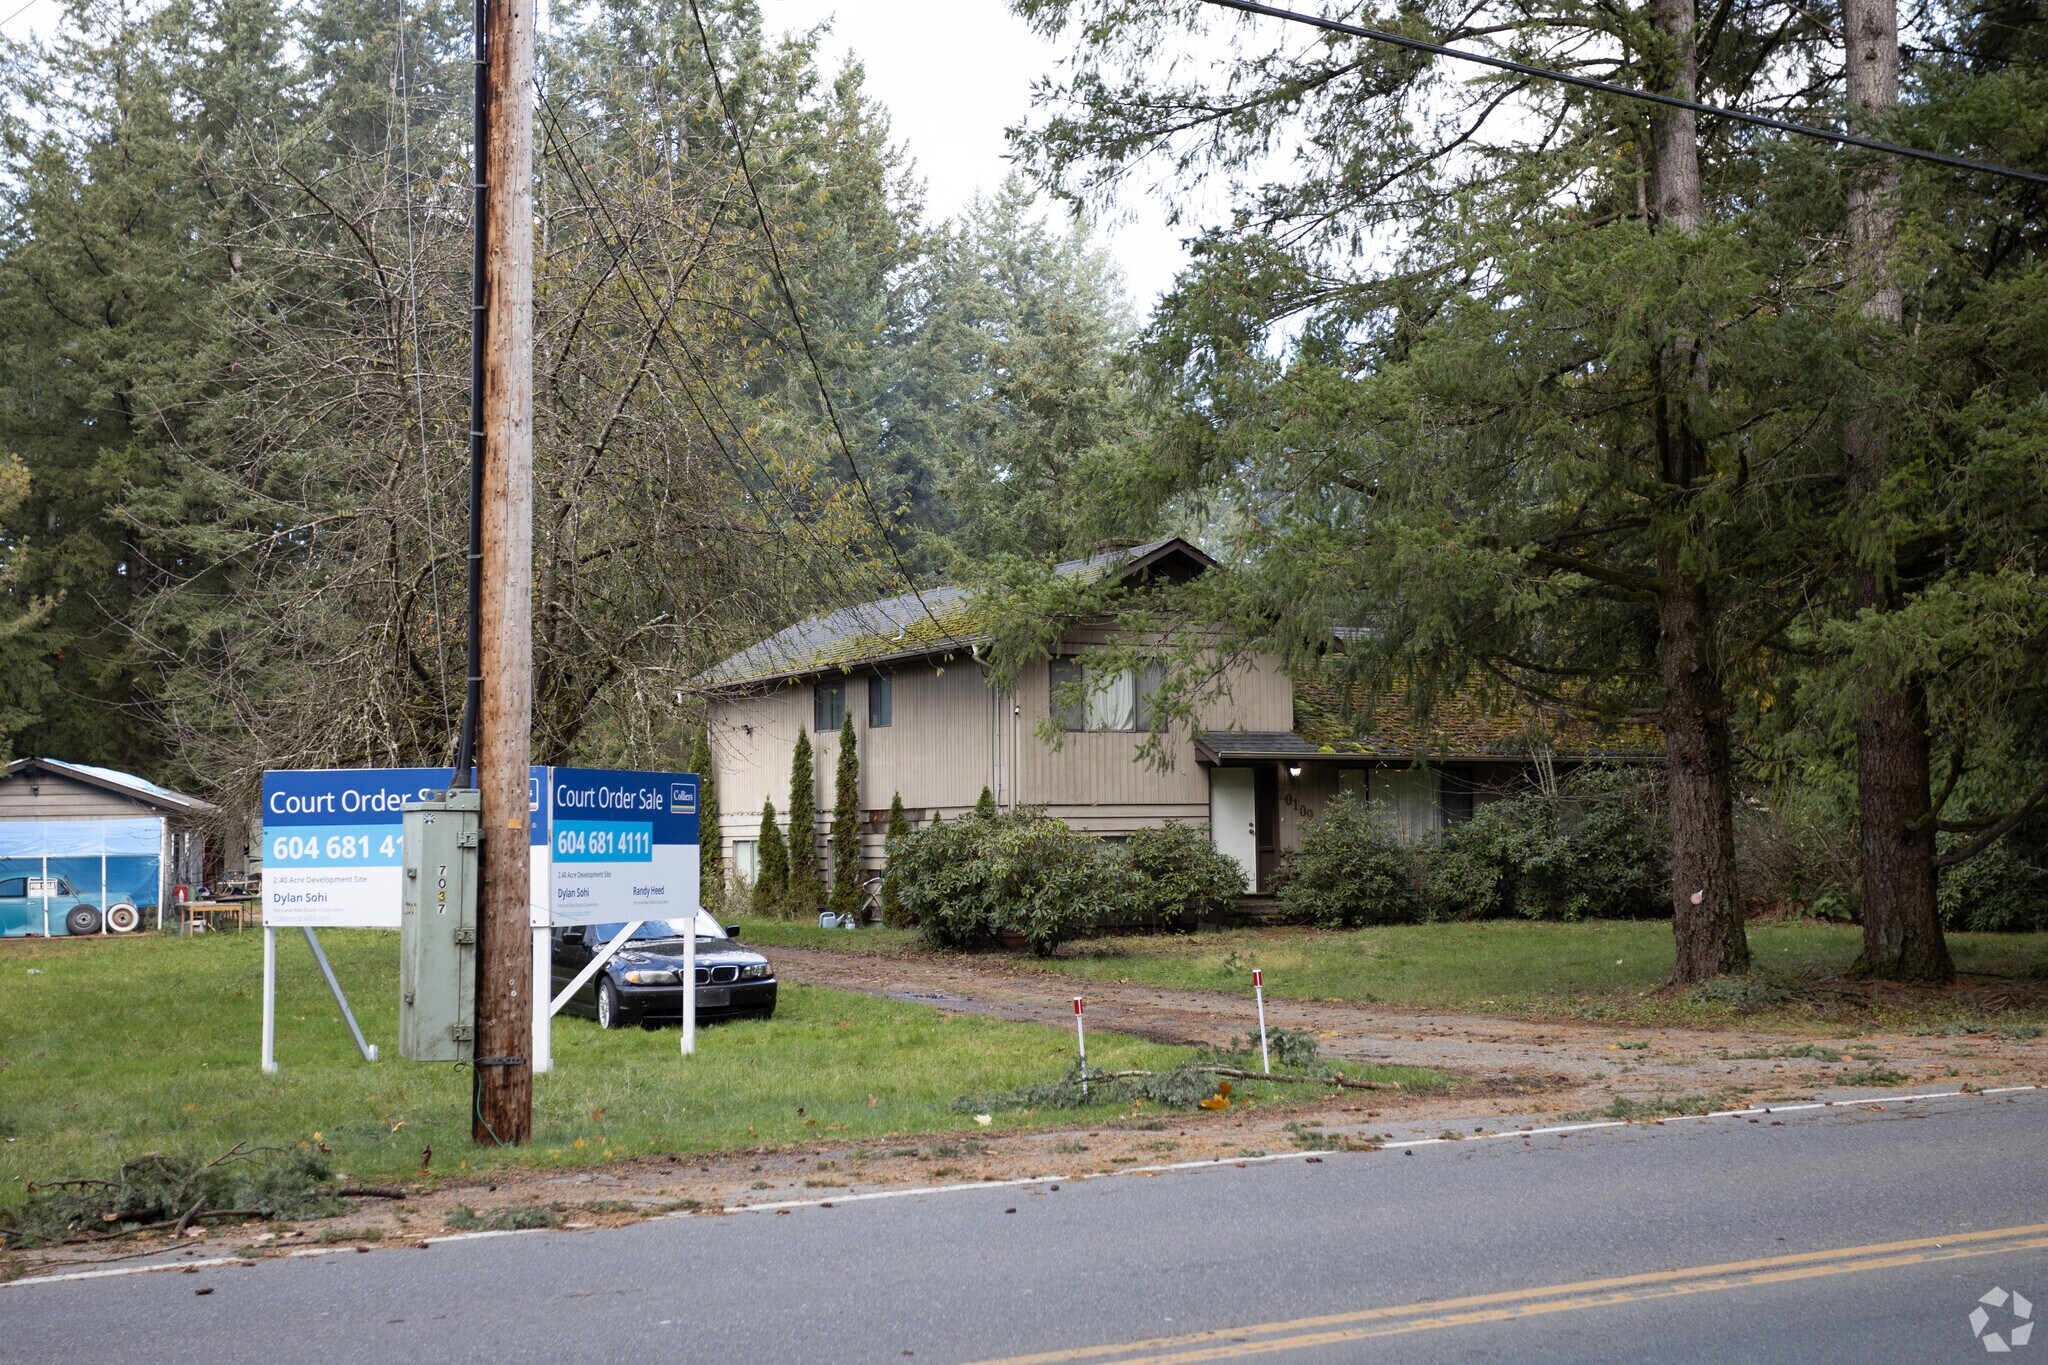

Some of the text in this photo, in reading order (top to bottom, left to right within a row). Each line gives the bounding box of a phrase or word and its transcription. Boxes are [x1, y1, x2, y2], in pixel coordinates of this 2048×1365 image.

[270, 791, 335, 814] Court
[341, 788, 411, 813] Order
[557, 784, 663, 810] Court Order Sale
[673, 789, 693, 801] Colliers
[273, 835, 320, 860] 604
[326, 835, 369, 859] 681
[558, 830, 649, 854] 604 681 4111
[273, 875, 367, 885] 2.40 Acre Development Site
[578, 871, 603, 879] Development
[438, 865, 447, 914] 7037
[557, 887, 590, 900] Dylan Sohi
[633, 885, 665, 898] Randy Heed
[273, 892, 328, 905] Dylan Sohi
